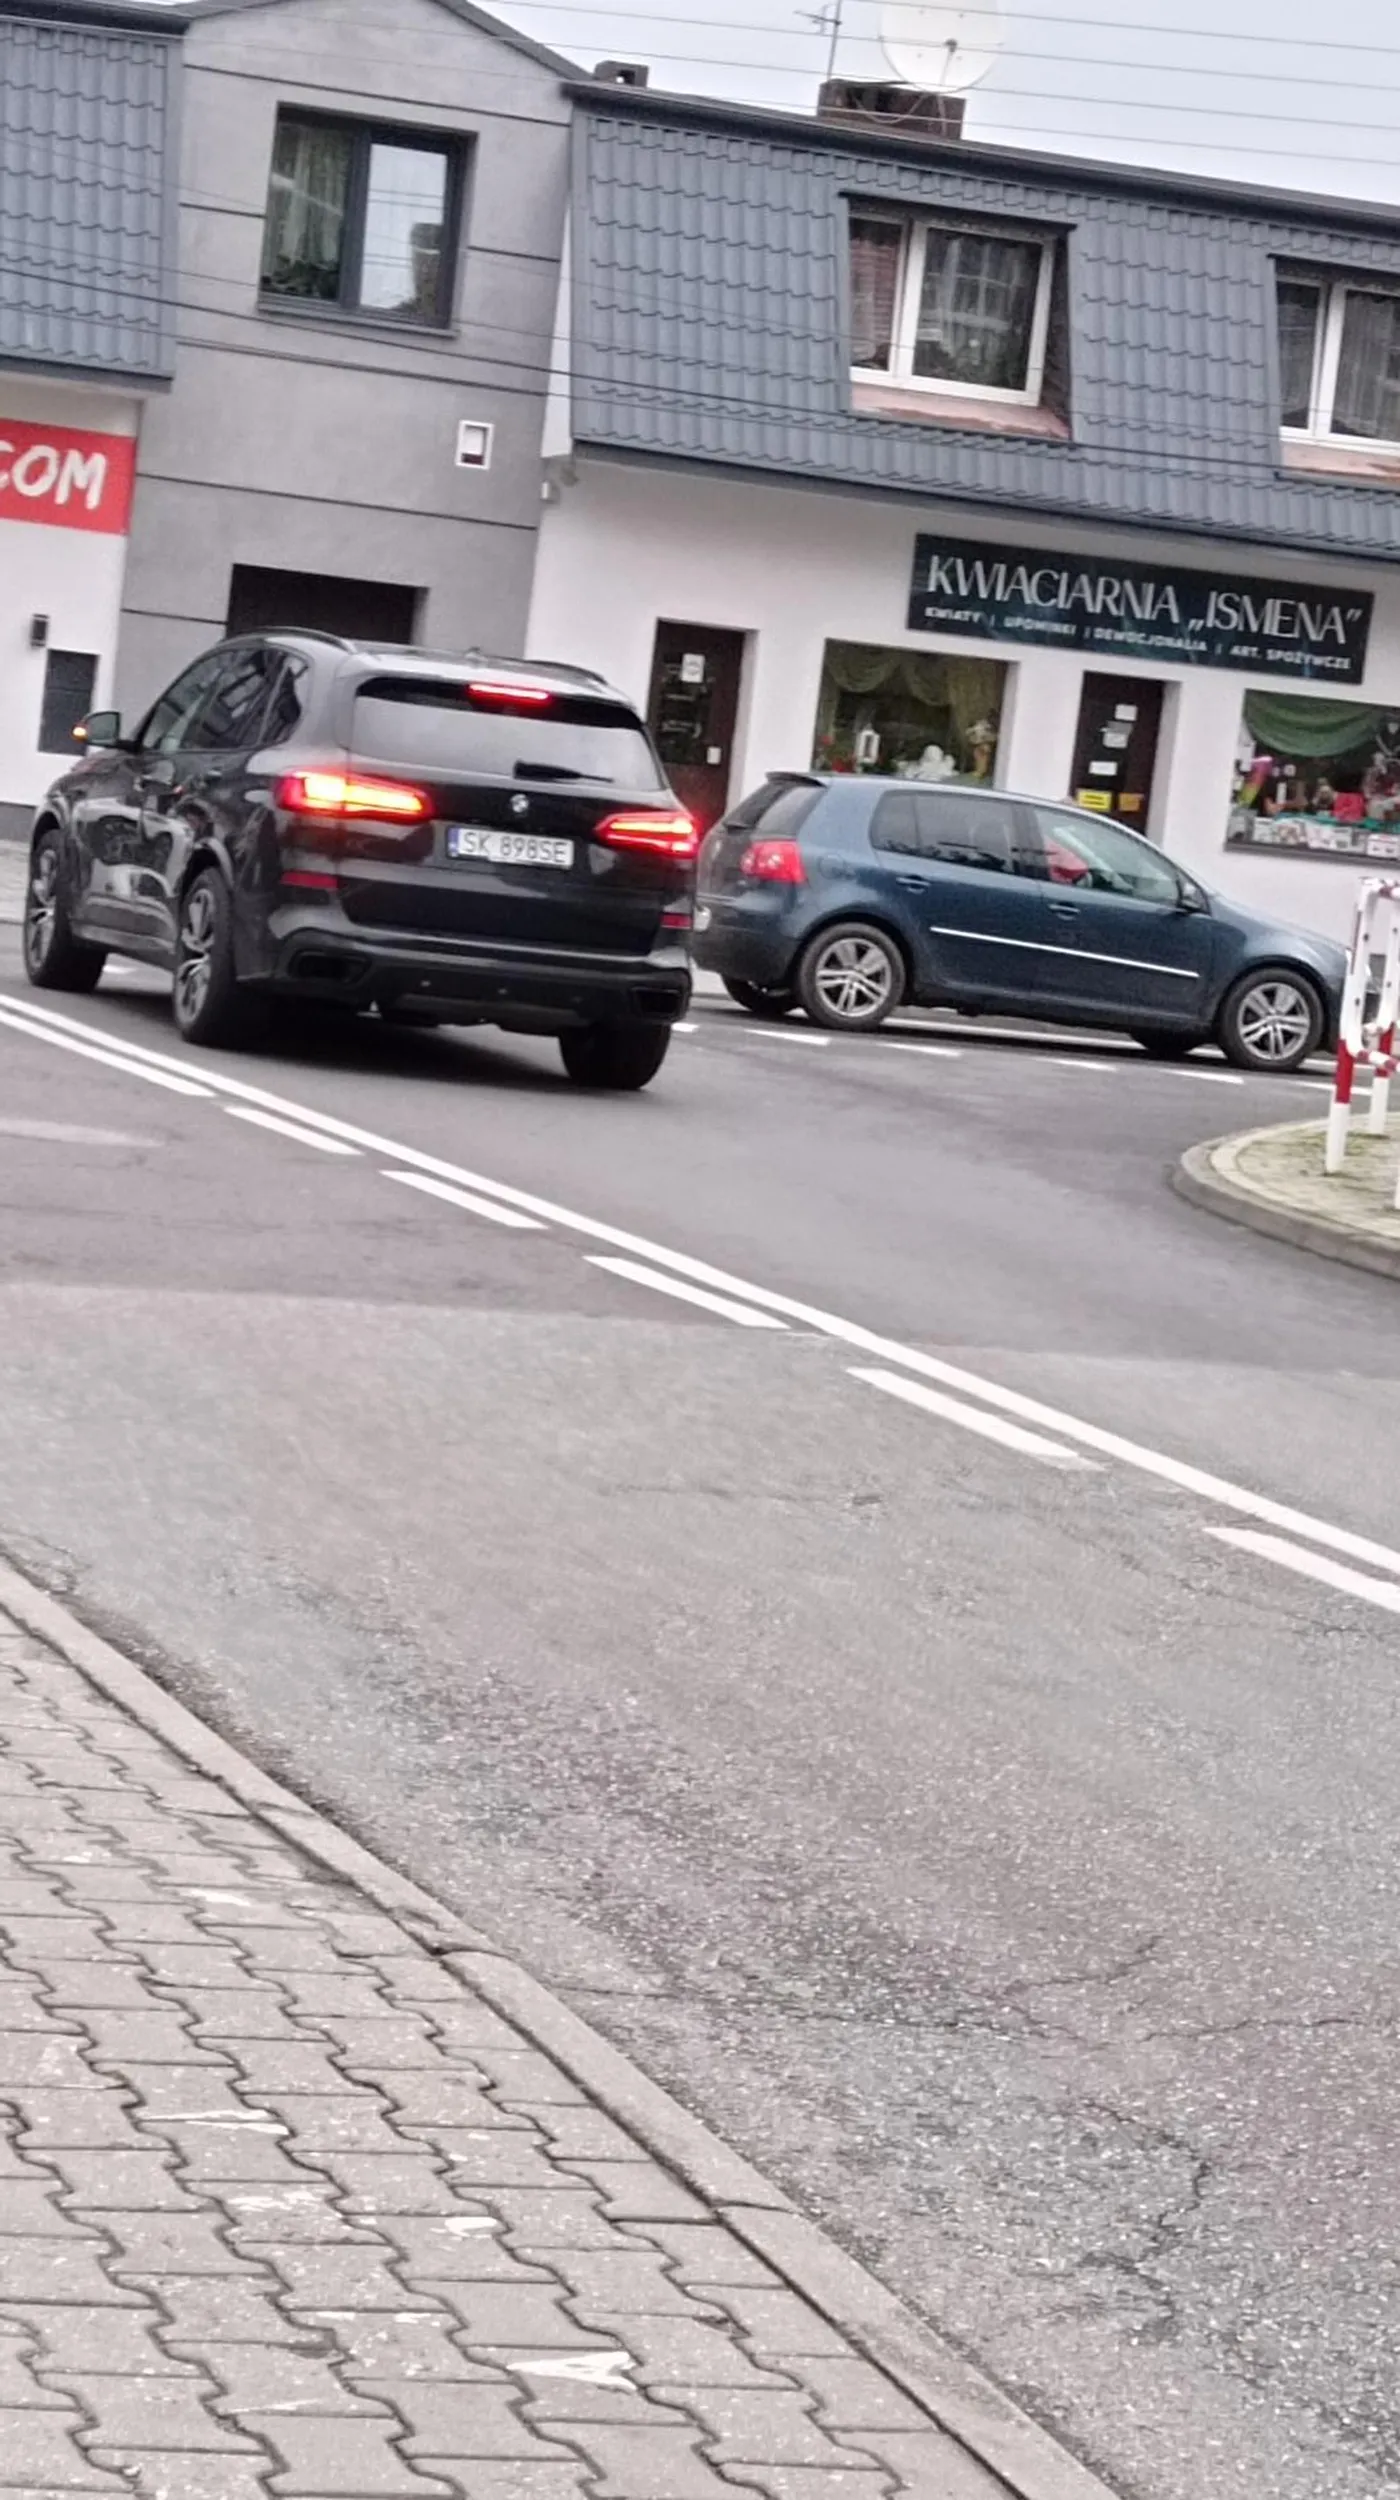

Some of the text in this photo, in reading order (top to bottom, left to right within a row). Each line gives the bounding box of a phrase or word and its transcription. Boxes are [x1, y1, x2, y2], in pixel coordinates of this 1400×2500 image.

[927, 554, 1180, 624] KWIACIARNIA
[924, 606, 981, 623] KWIATY
[1003, 616, 1077, 635] UPOMINKI
[1093, 627, 1207, 651] DEWOCJONALIA
[1230, 645, 1262, 659] ART.
[463, 831, 490, 854] SK
[501, 835, 568, 863] 898SE
